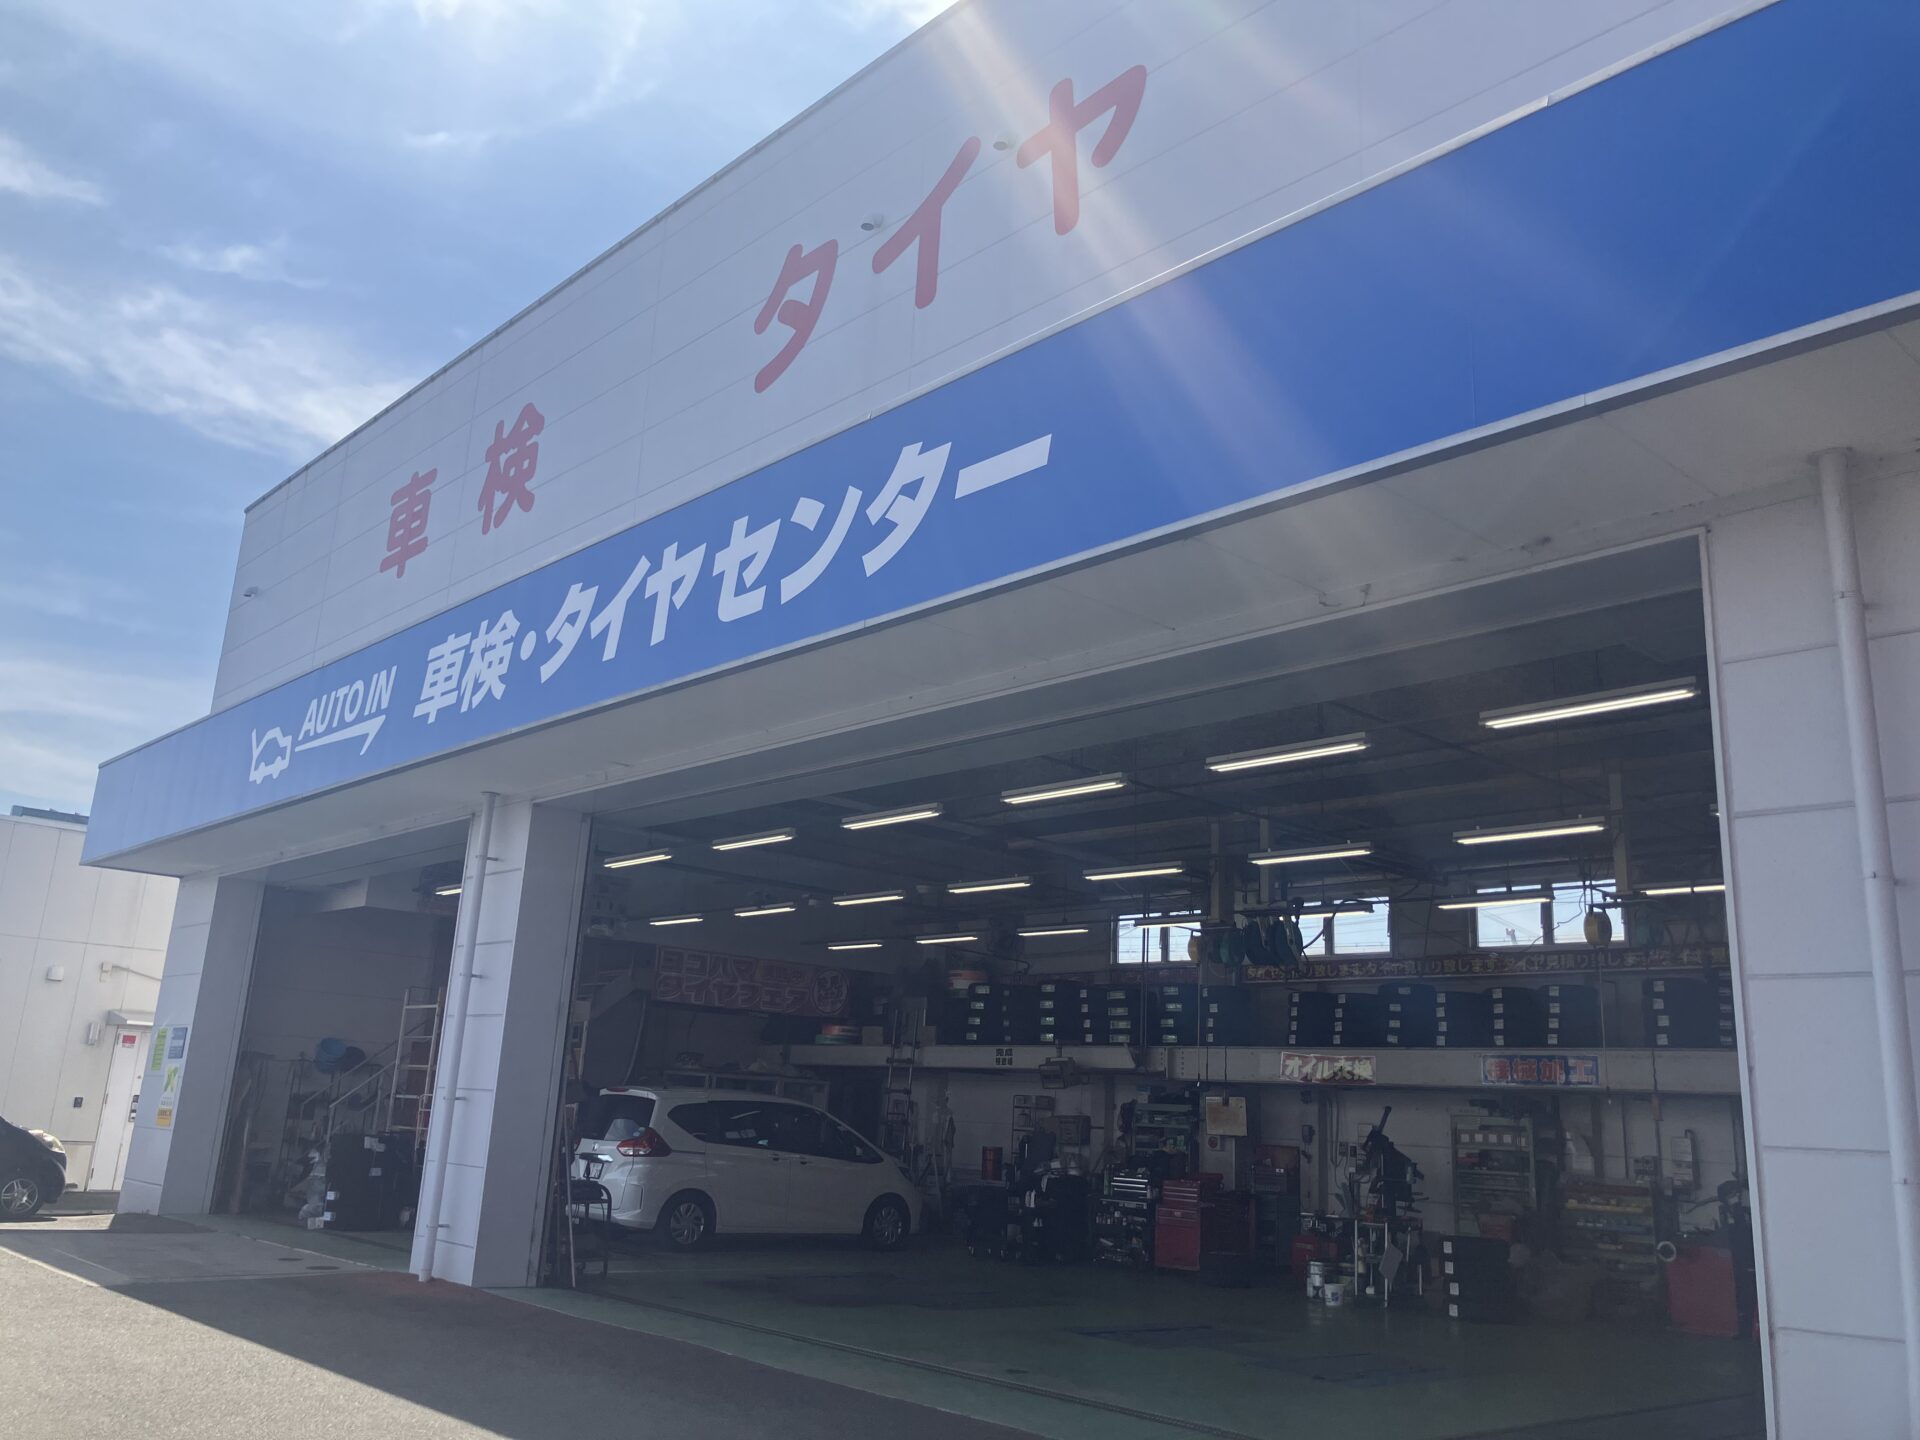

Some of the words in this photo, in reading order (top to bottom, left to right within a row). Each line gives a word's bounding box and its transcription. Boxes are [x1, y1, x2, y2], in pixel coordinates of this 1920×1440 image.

[379, 402, 545, 579] 車検
[754, 64, 1147, 393] タイヤ
[412, 433, 1053, 724] 車検・タイヤセンター
[298, 679, 364, 741] AUTO
[364, 665, 397, 716] IN
[1284, 1055, 1374, 1080] オイル交換
